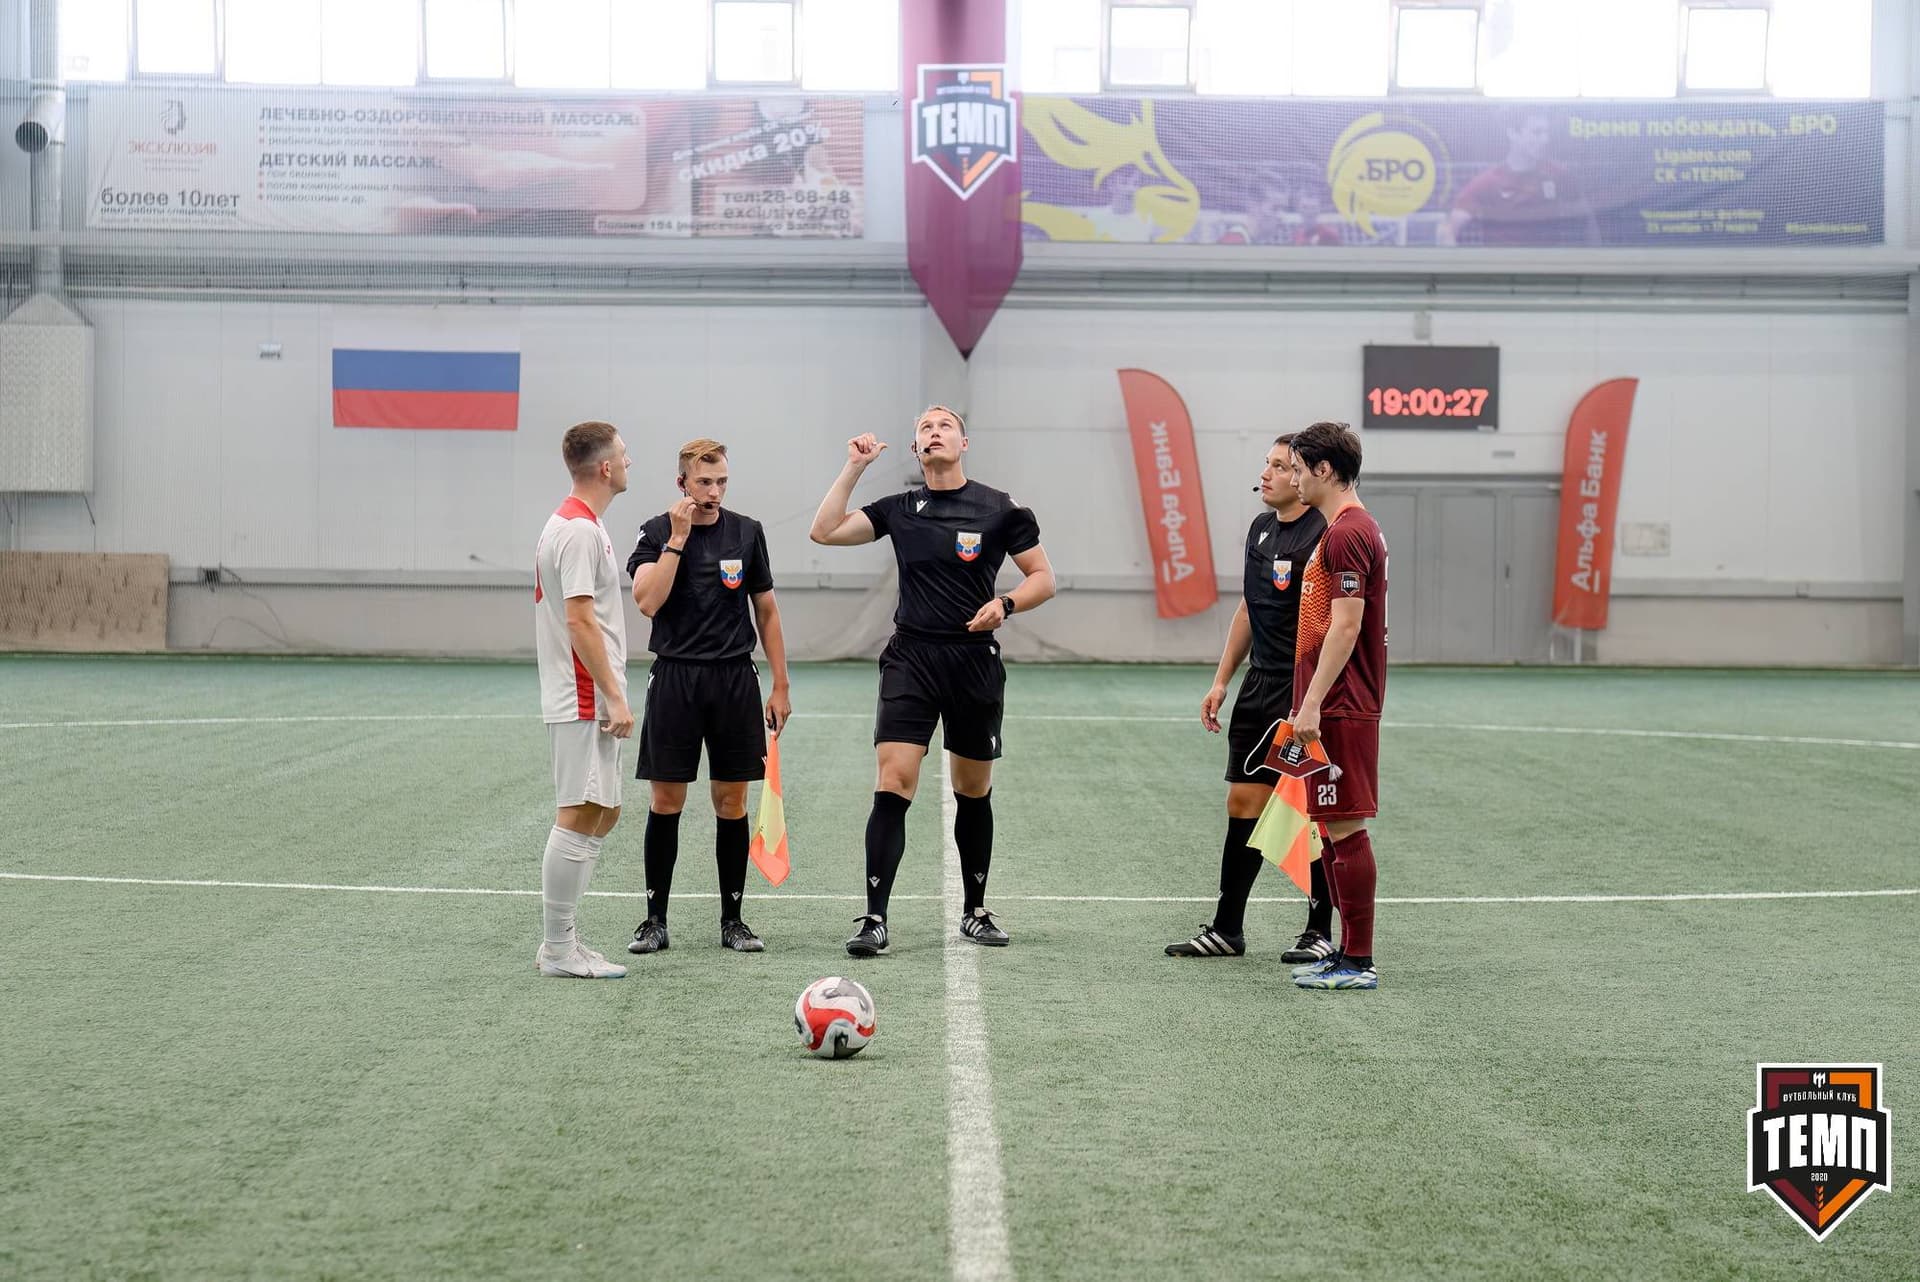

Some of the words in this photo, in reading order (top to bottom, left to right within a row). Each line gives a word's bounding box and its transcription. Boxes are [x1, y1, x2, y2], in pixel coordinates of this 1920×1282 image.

[921, 101, 1006, 148] ТЕМП
[1569, 116, 1641, 139] Время
[259, 151, 347, 168] ДЕТСКИЙ
[678, 144, 769, 182] скидка
[772, 120, 831, 154] 20%
[1357, 157, 1425, 182] .БРО
[101, 186, 169, 206] более
[178, 189, 240, 208] 10лет
[1367, 387, 1489, 417] 19:00:27
[1579, 429, 1608, 498] Банк
[1571, 503, 1601, 592] Альфа
[1317, 783, 1338, 806] 23
